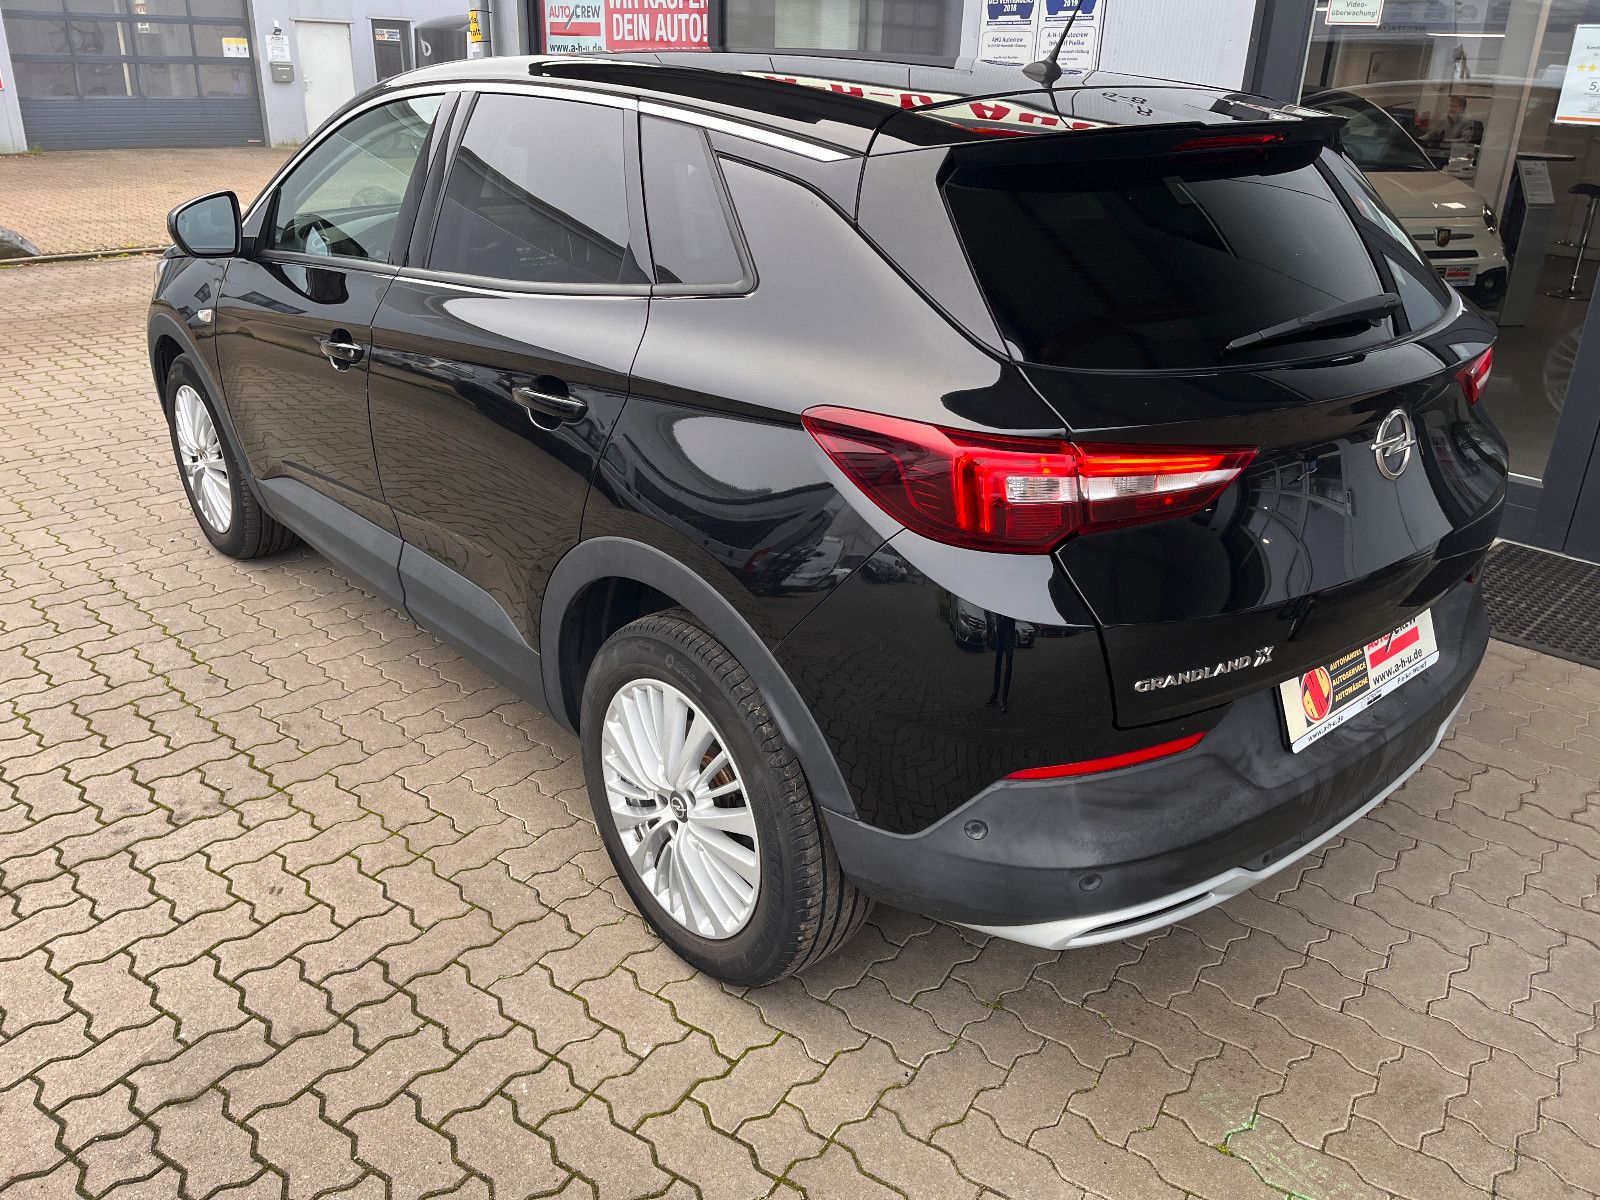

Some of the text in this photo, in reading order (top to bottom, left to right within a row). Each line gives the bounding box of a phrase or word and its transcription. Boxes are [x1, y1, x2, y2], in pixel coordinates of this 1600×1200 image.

[1003, 4, 1017, 12] 2018
[612, 13, 708, 42] DEIN AUTO!
[1134, 645, 1275, 693] GRANDLAND X
[1332, 661, 1367, 687] AUTOSERVICE
[1372, 648, 1423, 686] www.a-h-u.de
